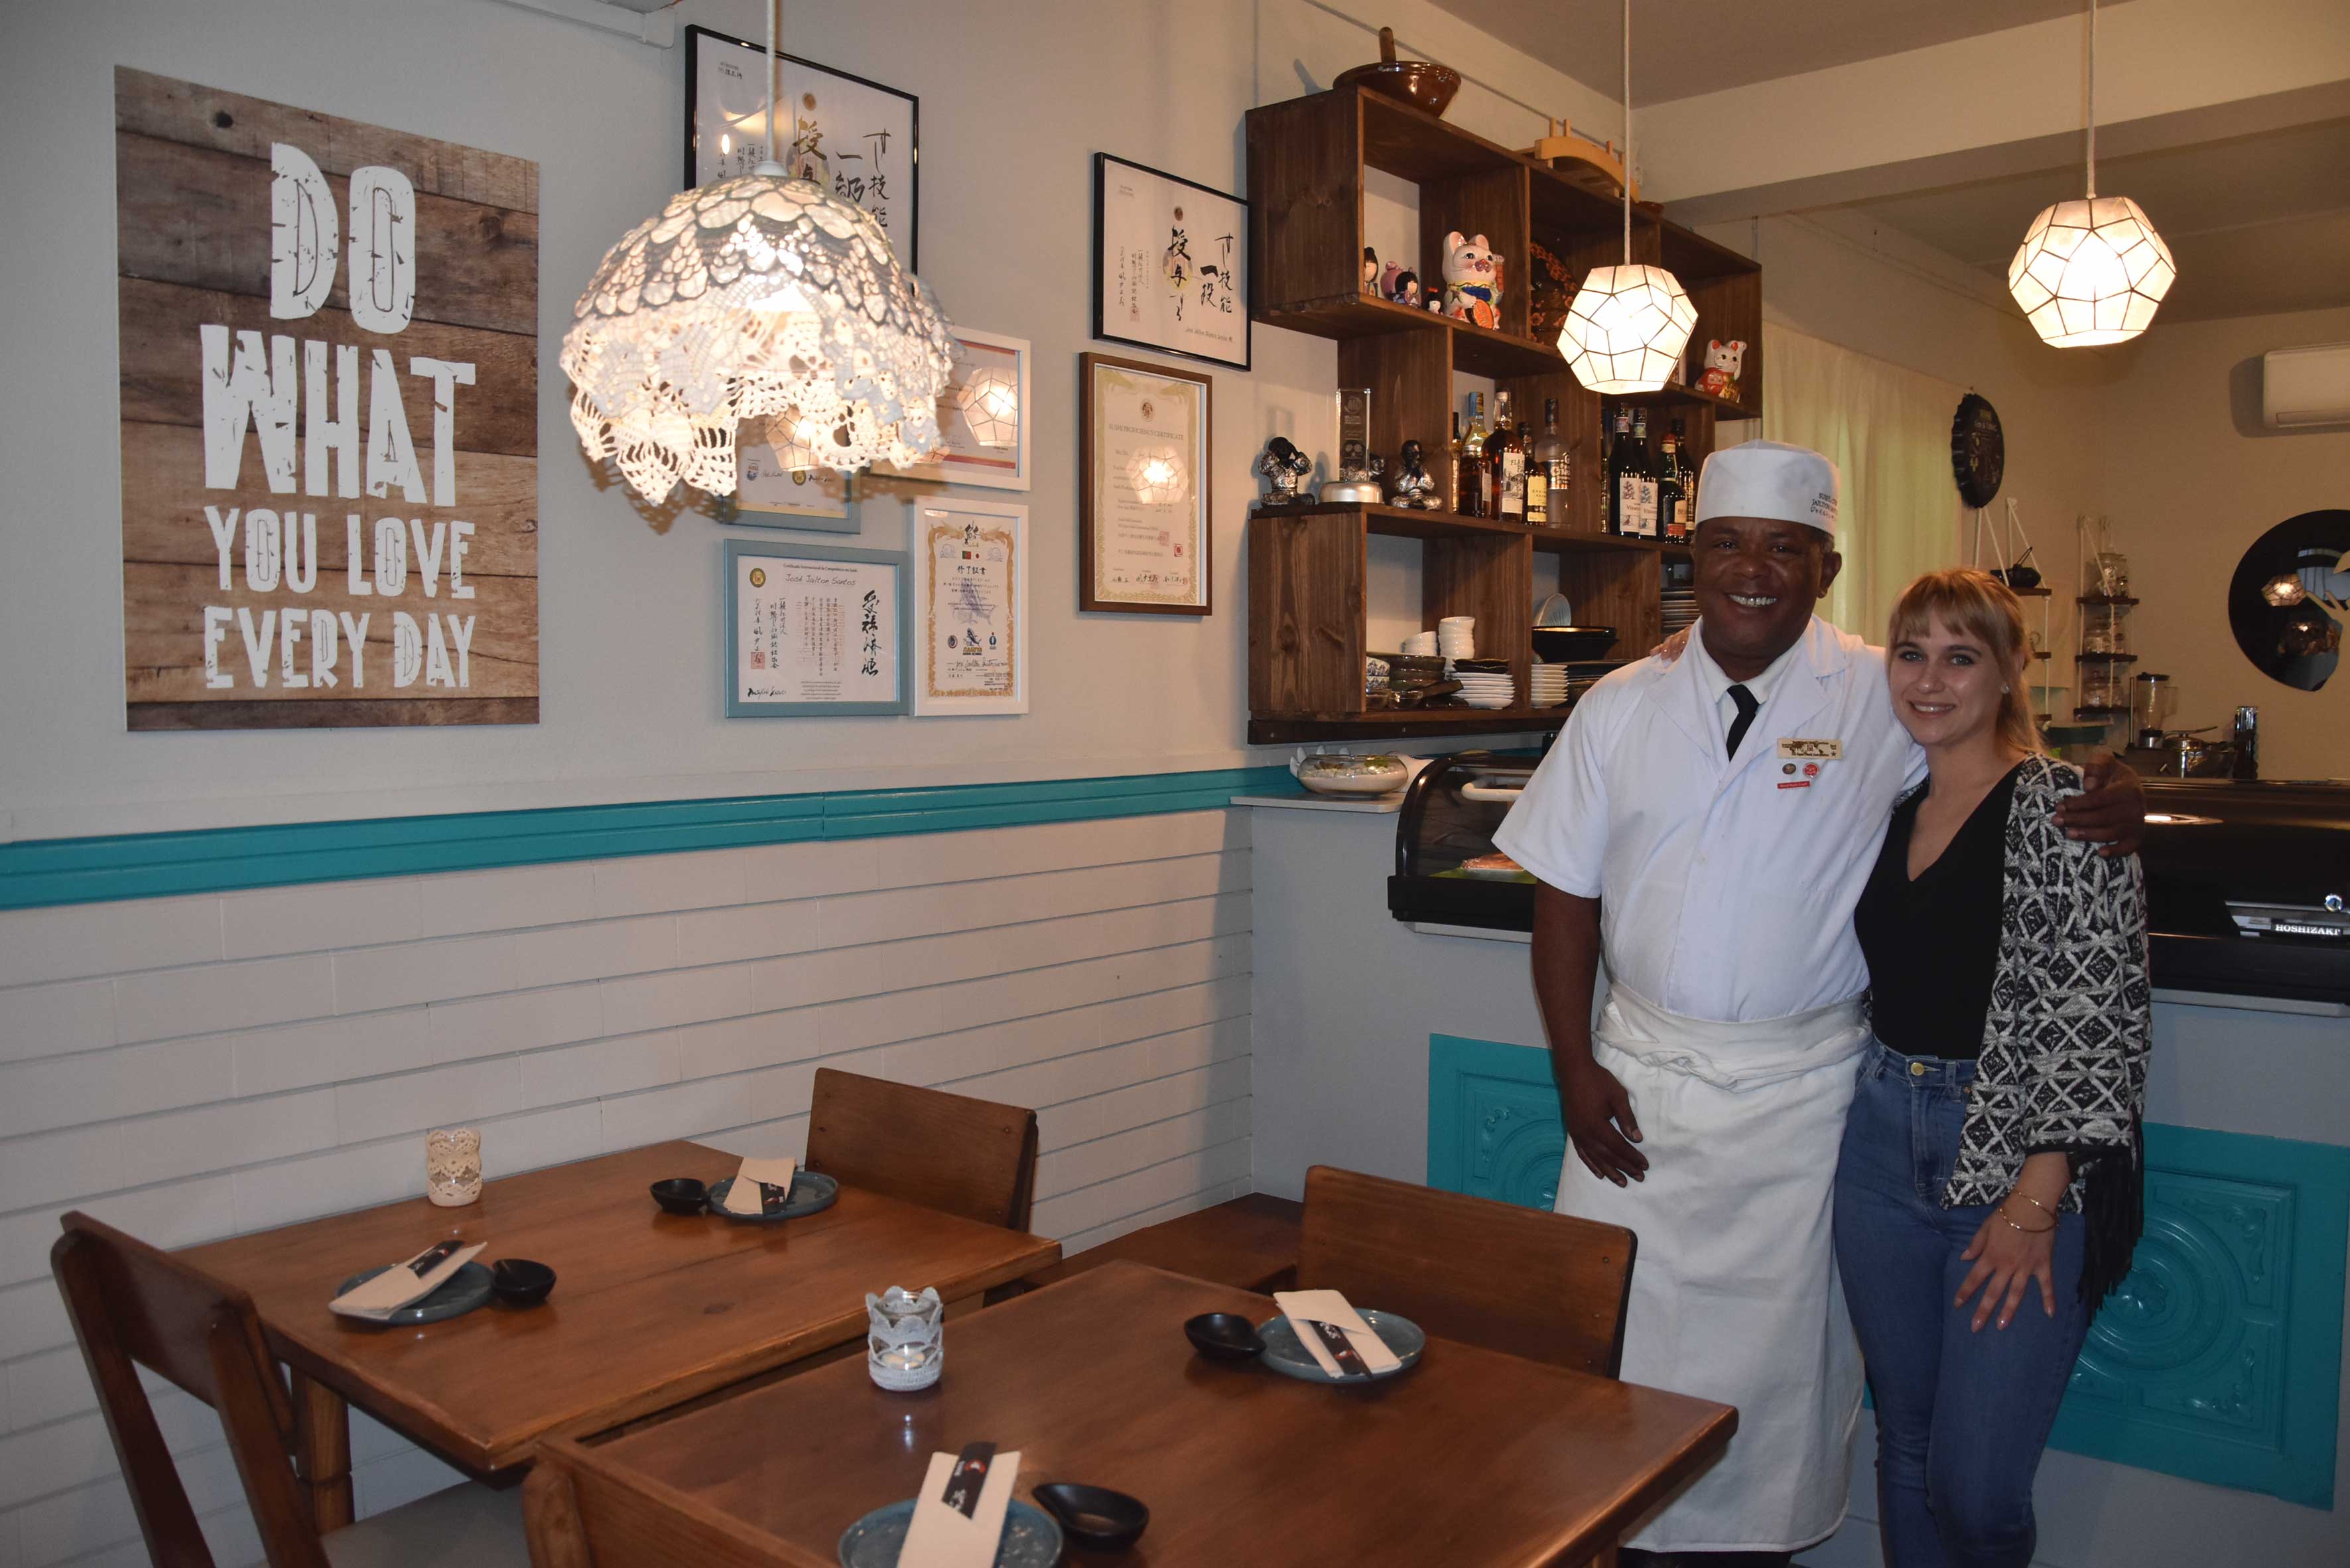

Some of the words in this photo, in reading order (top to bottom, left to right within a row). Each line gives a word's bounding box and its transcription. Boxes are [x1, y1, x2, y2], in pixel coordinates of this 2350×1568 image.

[271, 142, 416, 334] DO
[200, 324, 476, 506] WHAT
[204, 505, 317, 593] YOU
[347, 515, 476, 600] LOVE
[785, 573, 803, 582] José
[831, 577, 856, 586] Santos
[204, 606, 371, 690] EVERY
[393, 612, 476, 689] DAY
[2274, 924, 2341, 936] HOSHIZAKI
